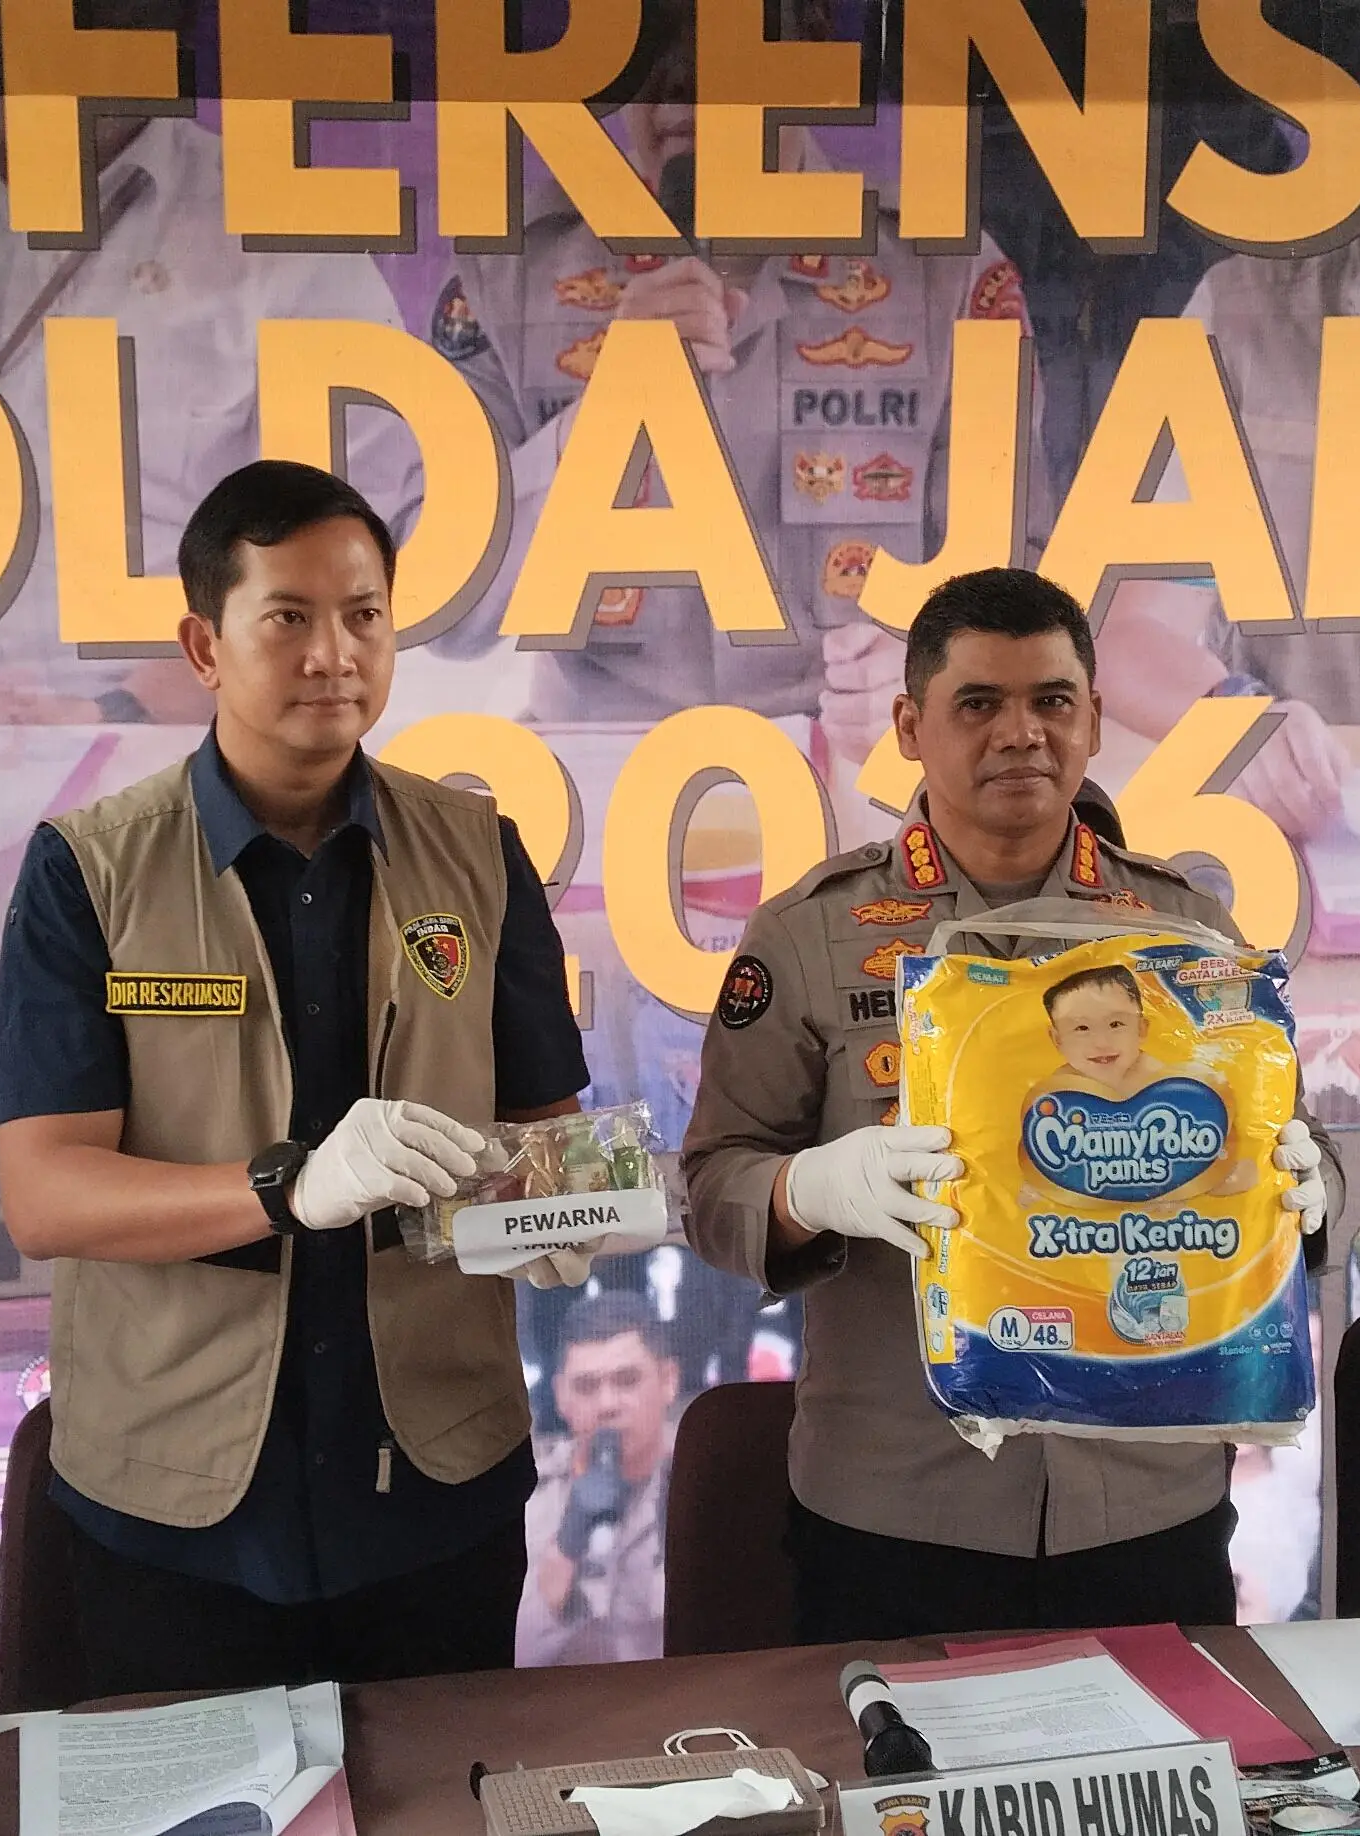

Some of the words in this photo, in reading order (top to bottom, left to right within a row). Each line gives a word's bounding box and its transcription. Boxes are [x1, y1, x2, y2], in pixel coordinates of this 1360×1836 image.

[792, 387, 921, 428] POLRI
[112, 982, 138, 1006] DIR
[139, 982, 241, 1007] RESKRIMSUS
[1037, 1100, 1217, 1166] MamyPoko
[1089, 1157, 1168, 1189] pants
[504, 1205, 621, 1235] PEWARNA
[1029, 1216, 1116, 1257] X-tra
[1122, 1213, 1238, 1258] Kering
[1124, 1257, 1152, 1282] 12
[1152, 1261, 1178, 1279] jam
[1000, 1316, 1018, 1338] M
[1033, 1324, 1059, 1346] 48
[1031, 1311, 1067, 1321] CELANA
[939, 1780, 1065, 1836] KABID
[1071, 1765, 1220, 1836] HUMAS
